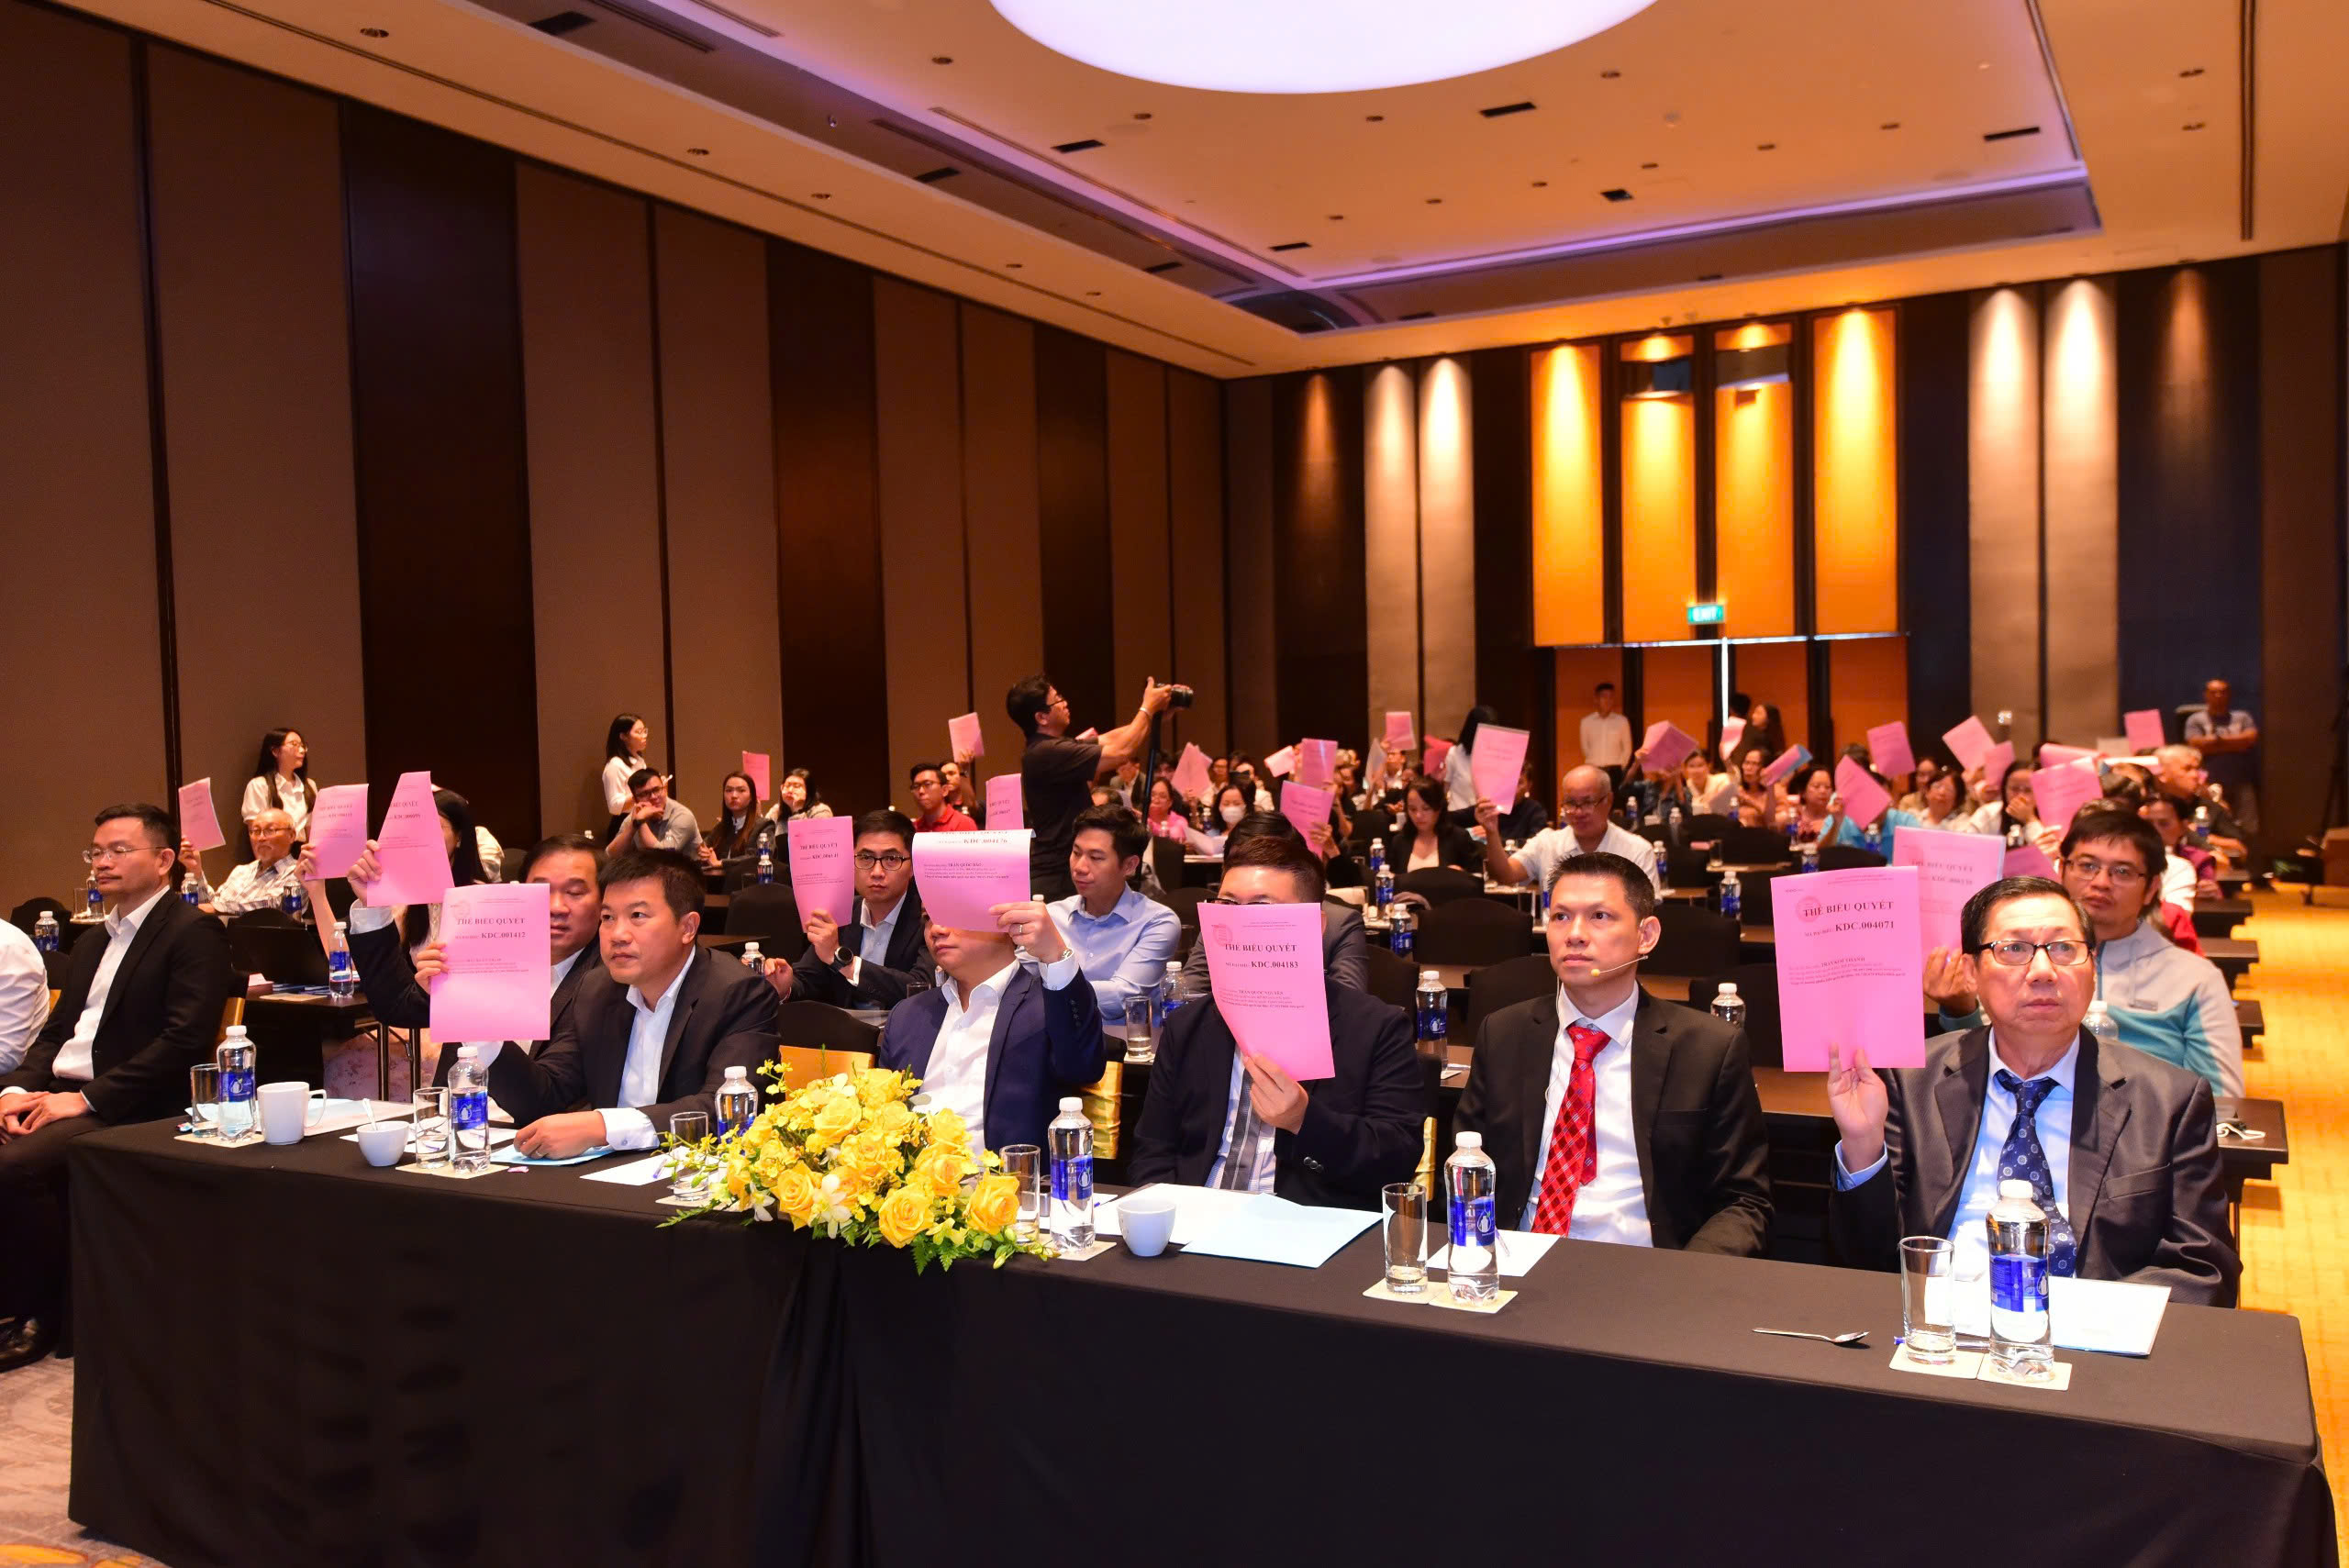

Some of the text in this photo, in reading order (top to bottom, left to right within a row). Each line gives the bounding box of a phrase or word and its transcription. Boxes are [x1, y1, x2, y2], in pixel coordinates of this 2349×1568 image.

[1835, 920, 1895, 932] KDC.004071
[481, 931, 526, 940] KDC.001412
[1251, 961, 1298, 969] KDC.004183
